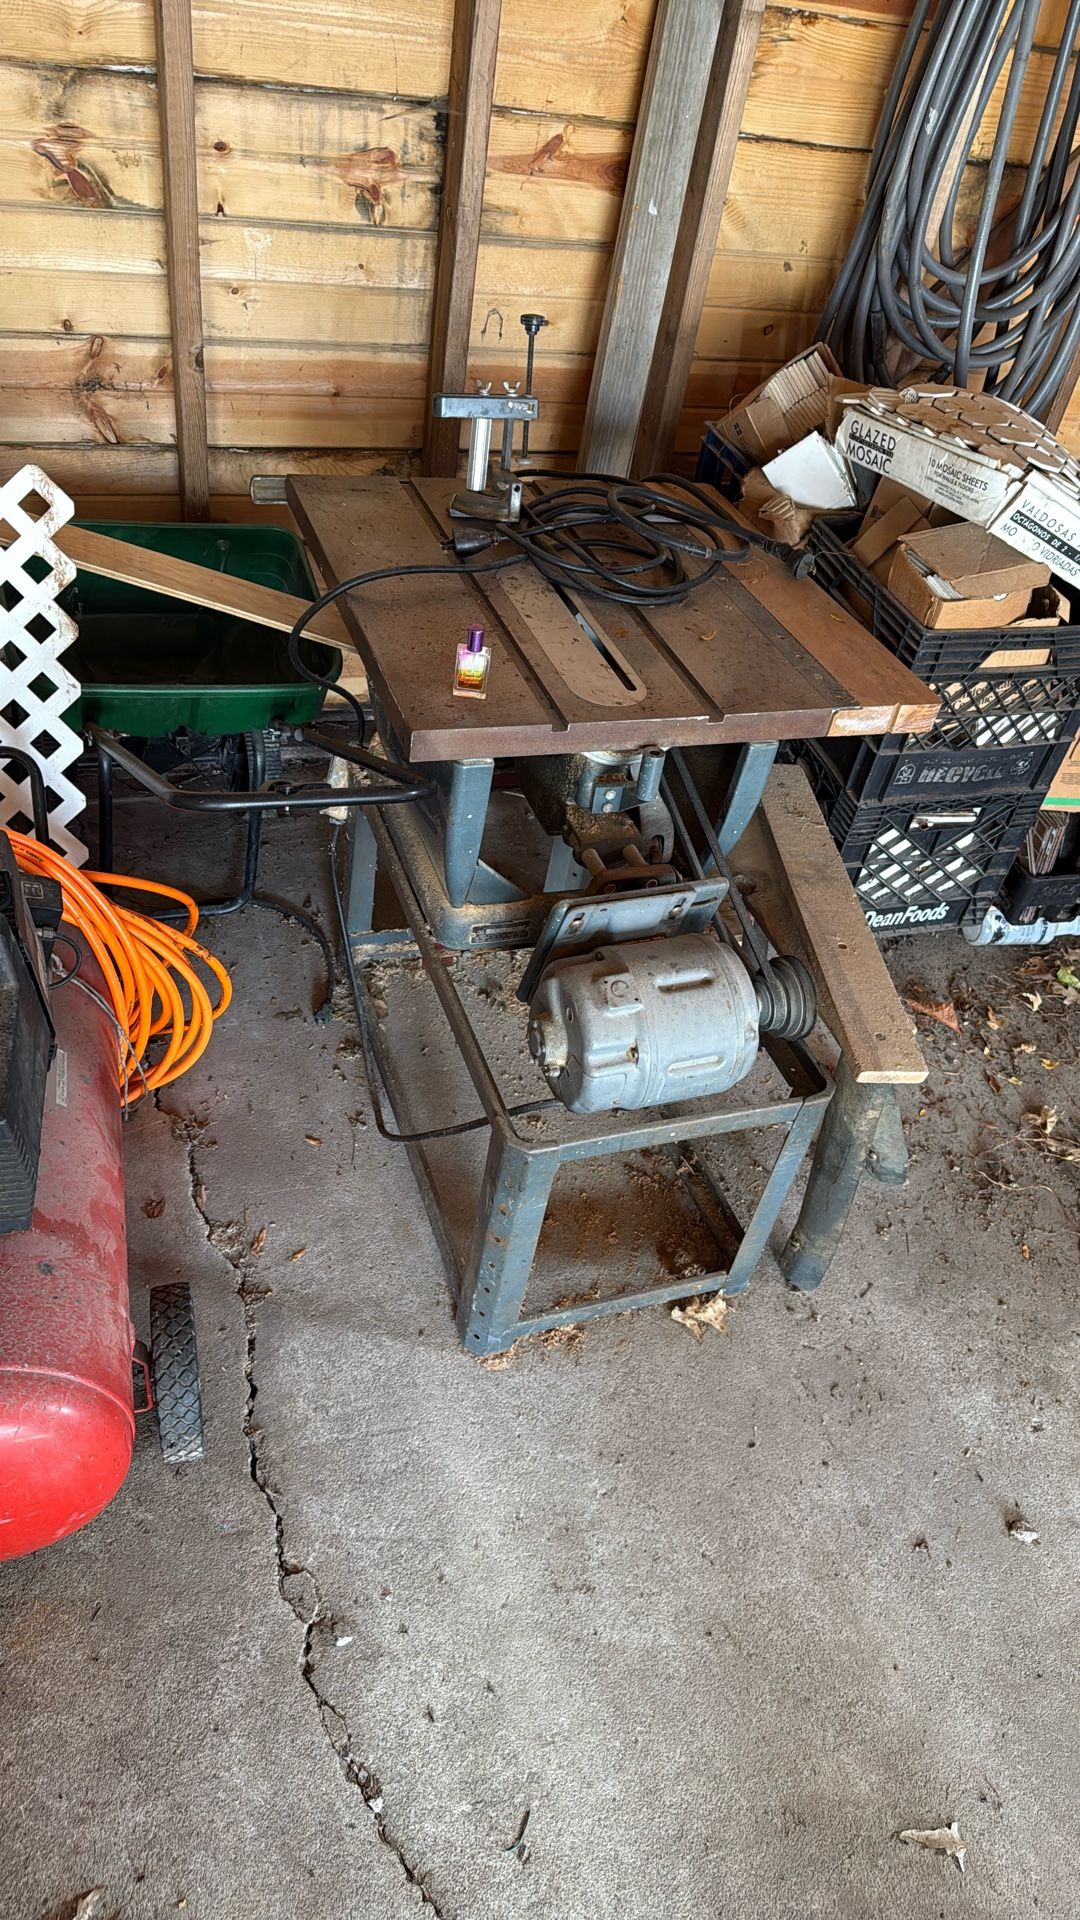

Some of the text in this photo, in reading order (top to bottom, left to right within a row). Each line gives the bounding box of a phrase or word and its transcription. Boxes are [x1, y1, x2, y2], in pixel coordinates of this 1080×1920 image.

[851, 420, 896, 451] GLAZED
[846, 443, 892, 474] MOSAIC
[936, 462, 962, 480] MOSAIC
[962, 473, 989, 491] SHEETS
[1022, 499, 1077, 541] VALDOSAS
[1051, 538, 1062, 549] DE
[1061, 545, 1068, 553] 2
[1039, 546, 1080, 576] VIDRIADAS
